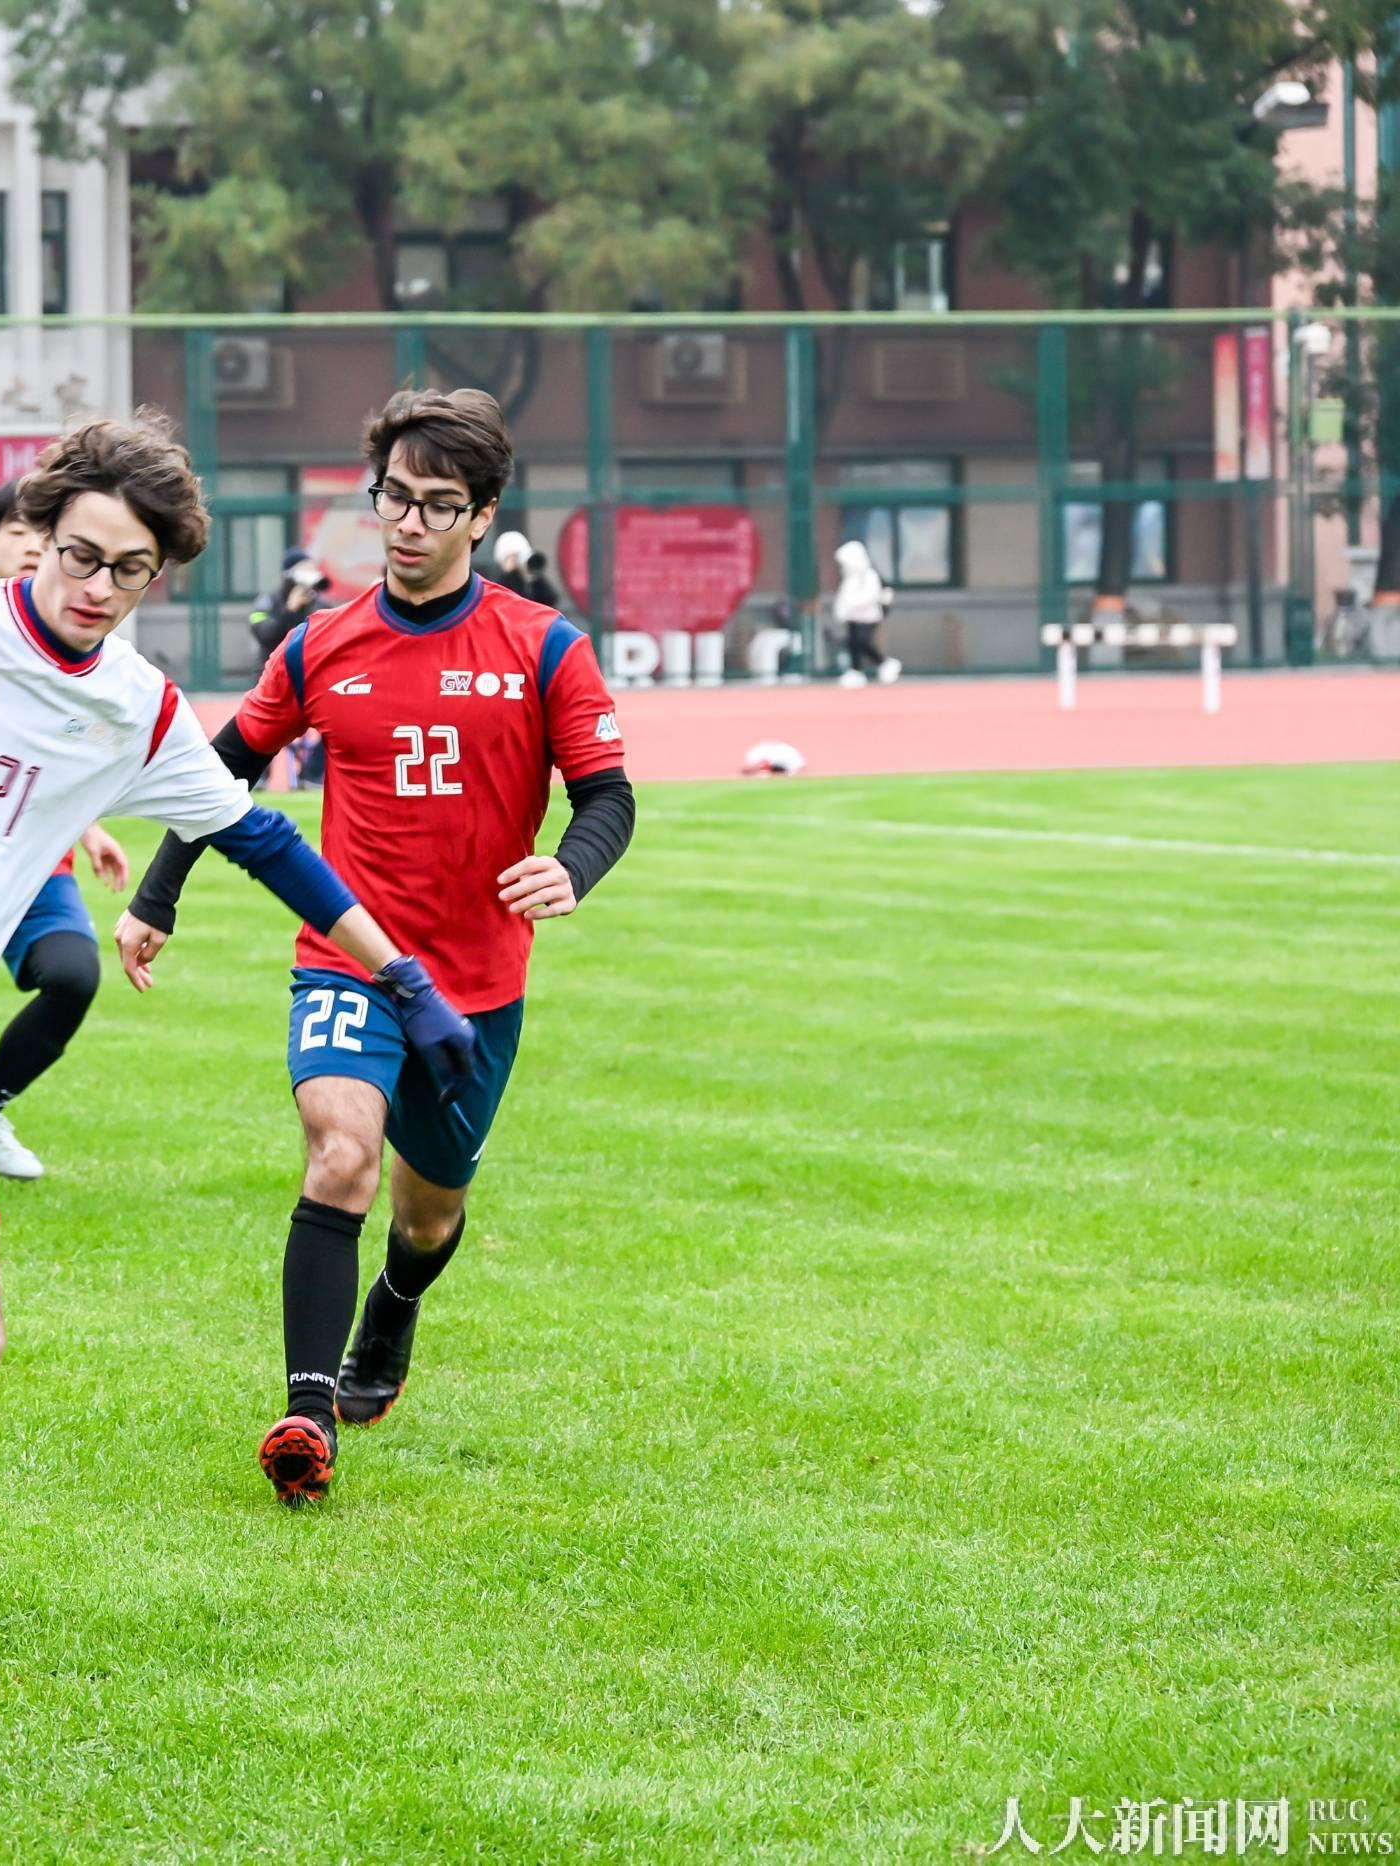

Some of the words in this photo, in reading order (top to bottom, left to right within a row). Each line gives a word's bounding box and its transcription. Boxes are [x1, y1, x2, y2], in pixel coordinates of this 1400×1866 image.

[440, 671, 473, 692] GW
[392, 725, 463, 796] 22
[300, 989, 369, 1052] 22
